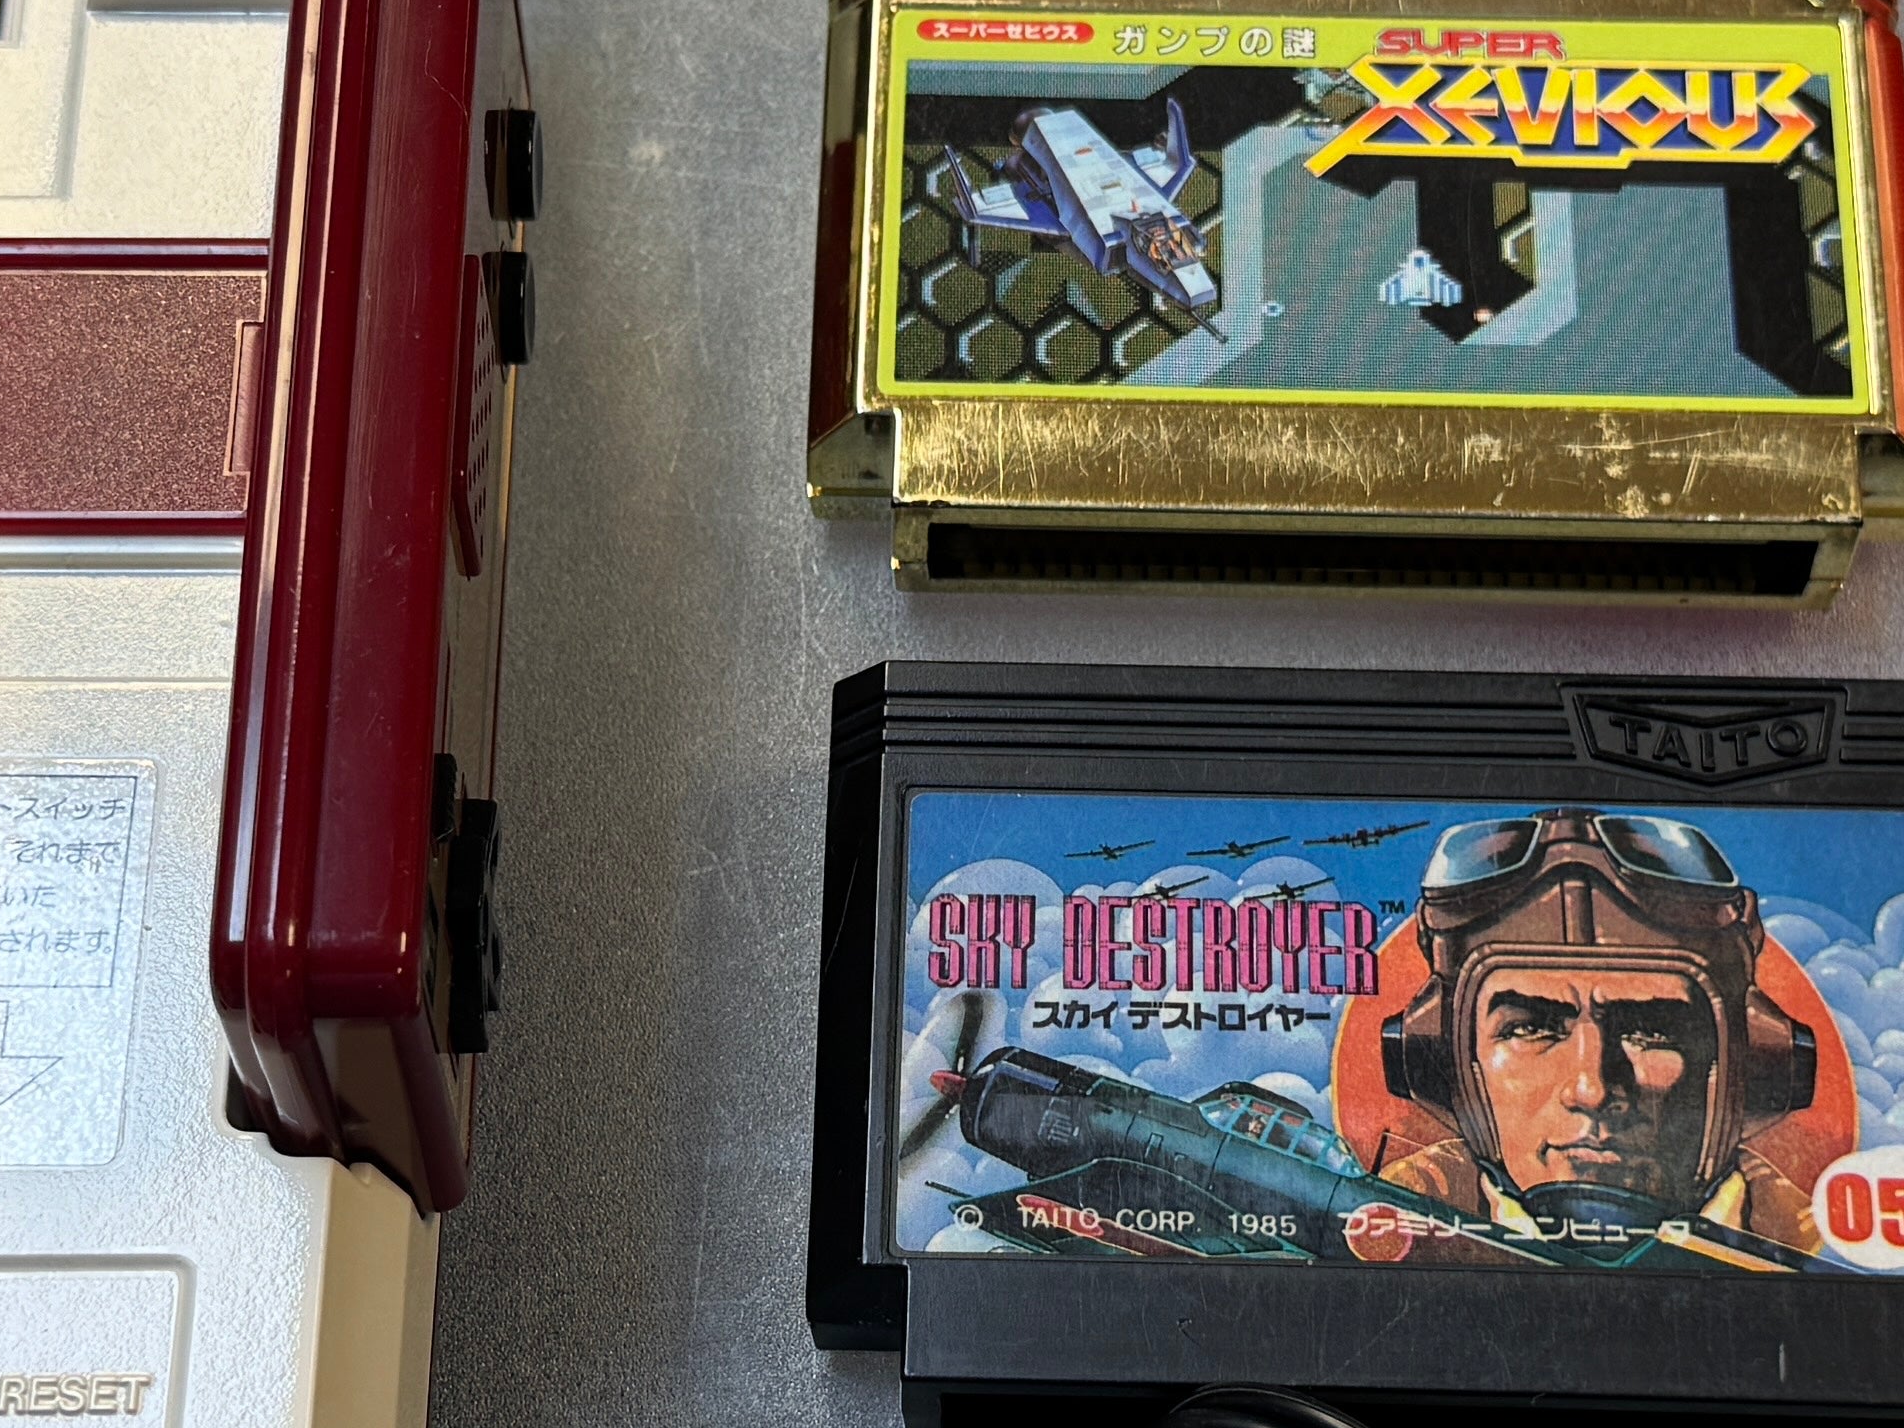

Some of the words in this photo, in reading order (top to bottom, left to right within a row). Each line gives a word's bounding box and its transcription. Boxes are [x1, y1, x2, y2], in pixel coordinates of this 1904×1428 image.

[1374, 28, 1567, 61] SUPER
[1304, 56, 1818, 174] XEVIOUS
[1609, 714, 1809, 772] TAITO
[927, 892, 1037, 990] SKY
[1032, 998, 1125, 1031] スカイ
[1128, 1000, 1332, 1033] デストロイヤー
[1016, 1206, 1100, 1231] TAITO
[1114, 1208, 1202, 1234] CORP.
[1228, 1213, 1297, 1237] 1985
[1335, 1211, 1493, 1238] ファミリー
